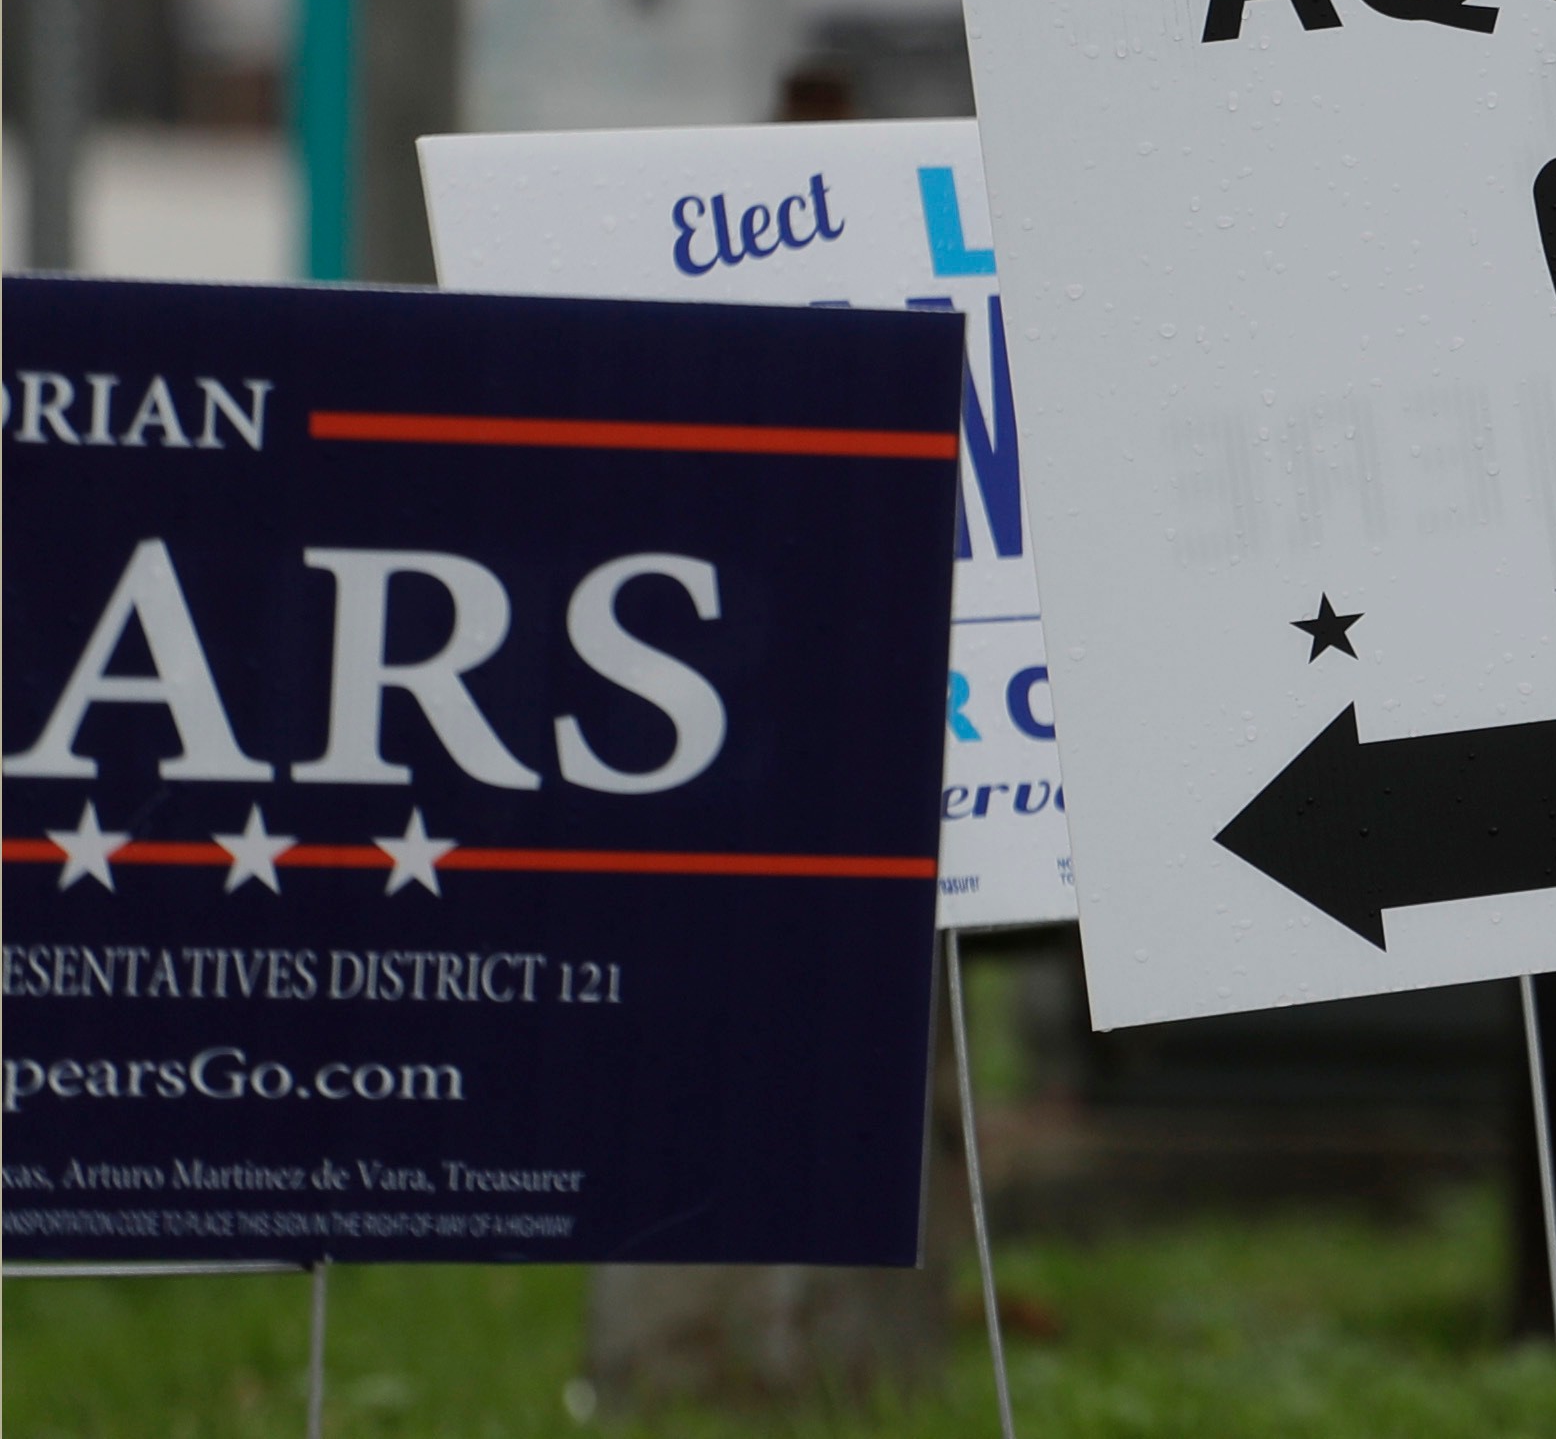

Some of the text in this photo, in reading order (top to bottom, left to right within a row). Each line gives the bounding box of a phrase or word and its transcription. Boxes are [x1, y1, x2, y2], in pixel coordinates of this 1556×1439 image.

[673, 173, 844, 276] Elect
[2, 370, 275, 452] RIAN
[3, 537, 728, 794] ARS
[328, 949, 547, 1003] DISTRICT
[559, 961, 622, 1004] 121
[2, 1046, 466, 1112] pearsGo.com
[62, 1157, 165, 1190] Arturo
[172, 1157, 306, 1191] Martinez
[311, 1157, 351, 1191] de
[357, 1159, 436, 1194] Vara,
[442, 1160, 586, 1193] Treasurer
